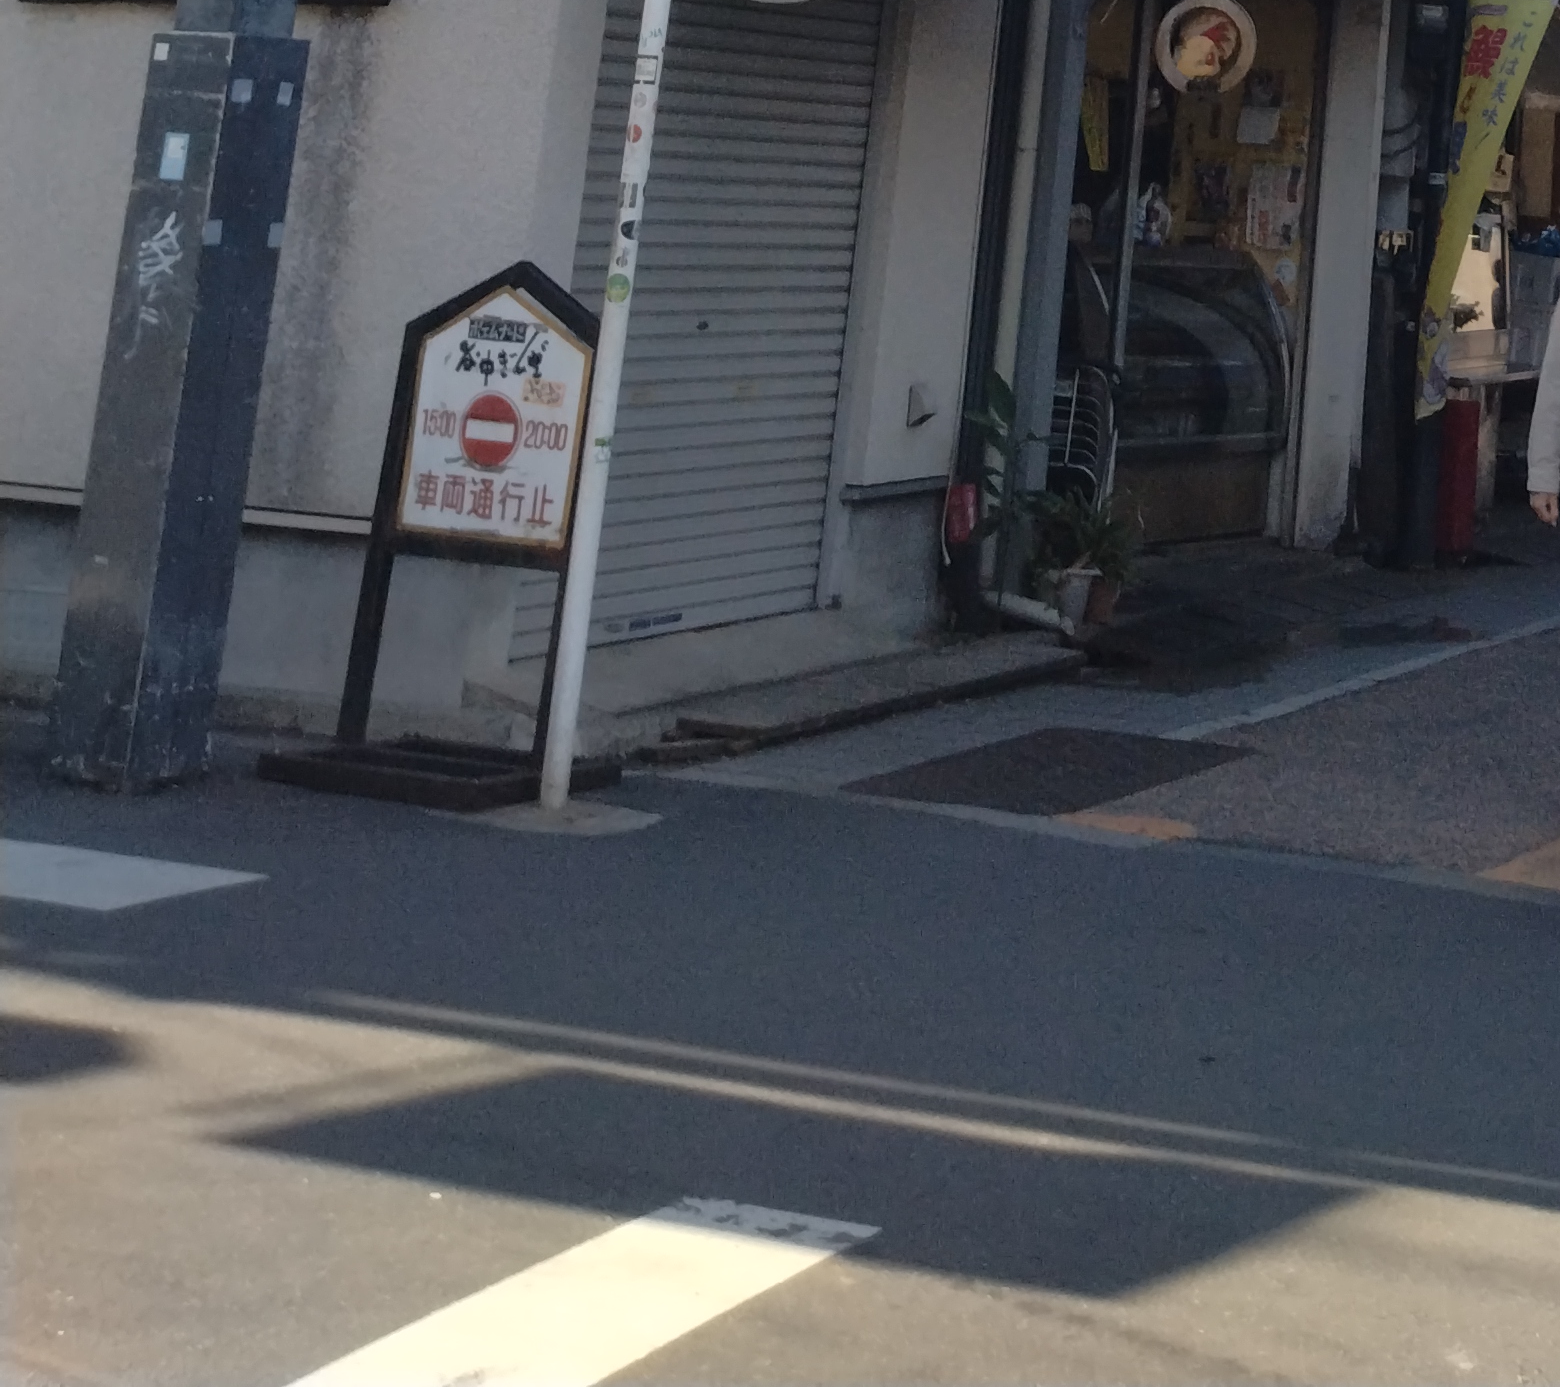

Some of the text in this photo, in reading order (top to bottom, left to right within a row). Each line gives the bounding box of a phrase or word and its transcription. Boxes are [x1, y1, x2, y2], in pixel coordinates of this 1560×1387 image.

[422, 407, 456, 439] 15:00
[523, 422, 568, 451] 20:00
[415, 472, 555, 527] 車両通行止
